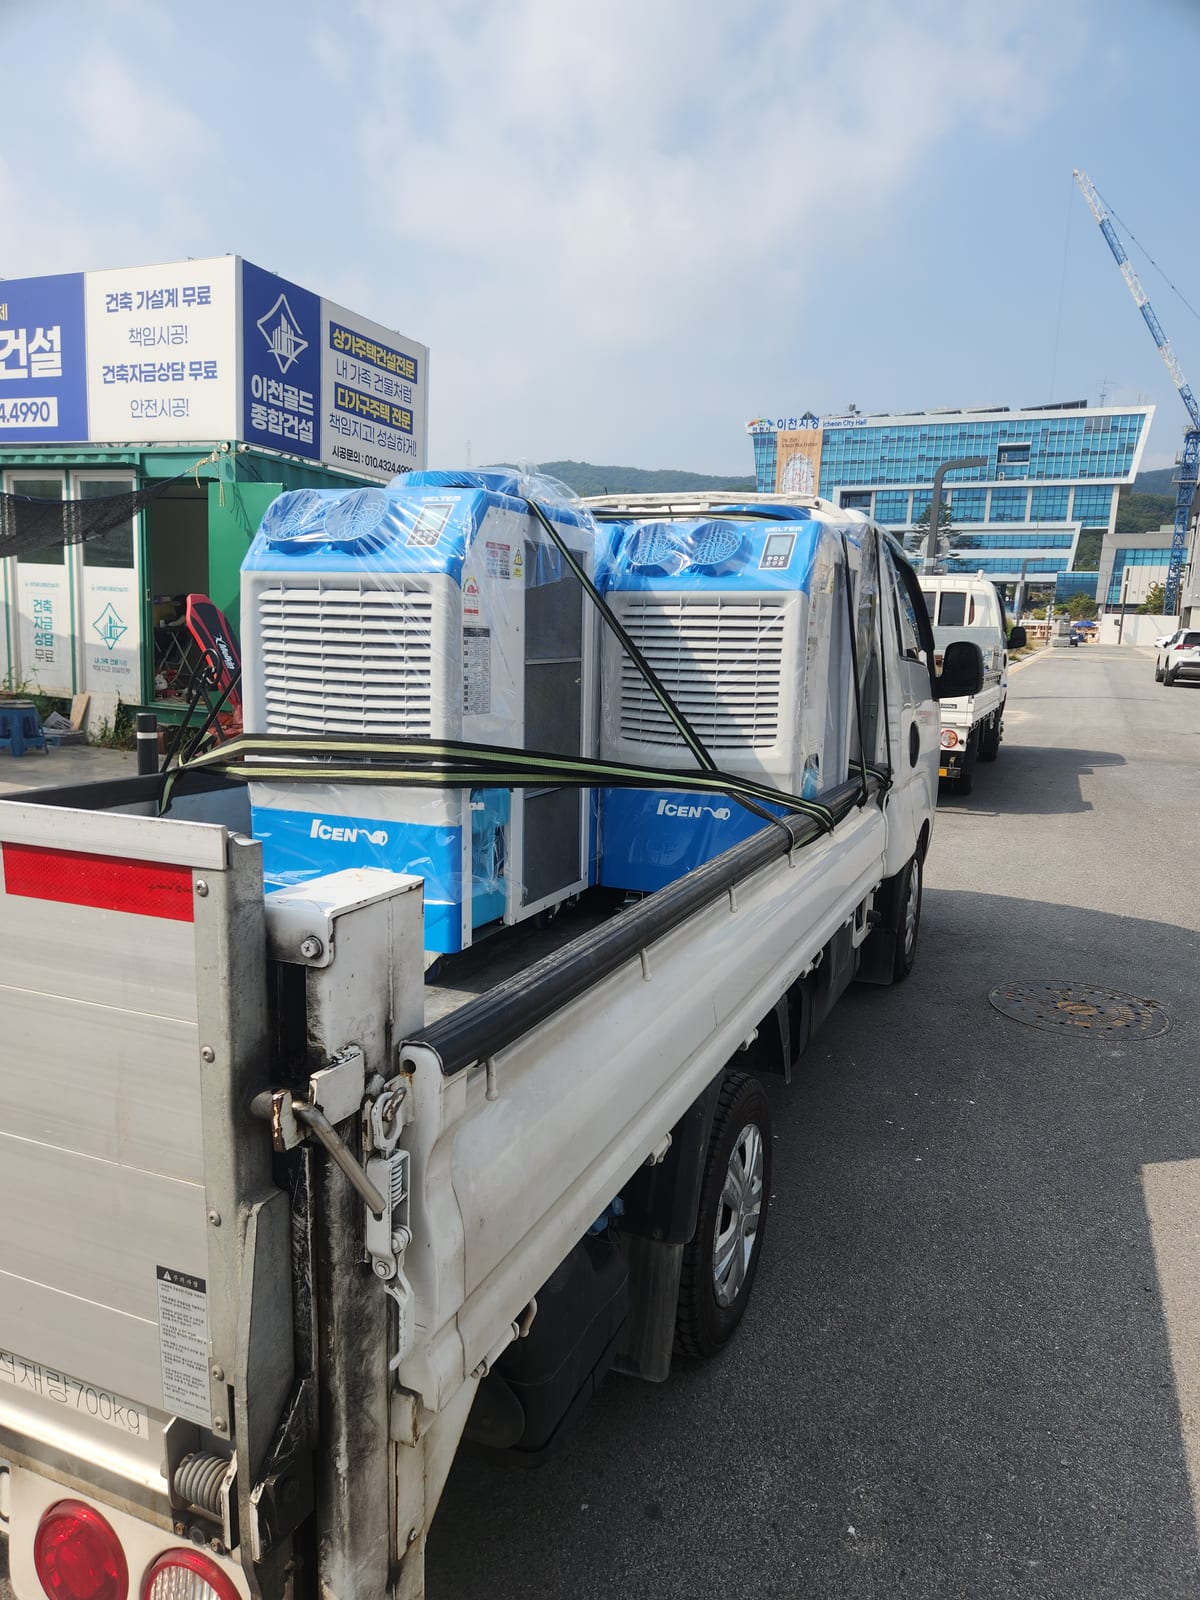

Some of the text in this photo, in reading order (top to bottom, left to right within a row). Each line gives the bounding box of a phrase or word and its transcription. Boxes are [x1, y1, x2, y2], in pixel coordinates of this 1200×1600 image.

[105, 285, 212, 313] 건축 가설계 무료
[128, 324, 188, 346] 책임시공!
[0, 325, 62, 380] 건설
[333, 328, 415, 380] 상가주택건설전문
[102, 360, 218, 384] 건축자금상담 무료
[336, 357, 412, 404] 내 가족 건물처럼
[250, 374, 314, 416] 이천골드
[130, 398, 190, 418] 안전시공!
[336, 387, 411, 430] 다가구주택 전문
[250, 403, 314, 444] 종합건설
[776, 417, 820, 430] 이천시청
[823, 421, 842, 430] Icheon
[842, 420, 854, 428] City
[329, 414, 417, 457] 책임지고! 성실하게!
[332, 445, 361, 463] 시공문의
[33, 599, 52, 614] 건축
[34, 616, 52, 630] 자금
[34, 632, 54, 647] 상담
[35, 649, 54, 663] 무료
[656, 799, 702, 818] ICEN
[310, 819, 358, 843] ICEN
[173, 1274, 198, 1288] 주의사항
